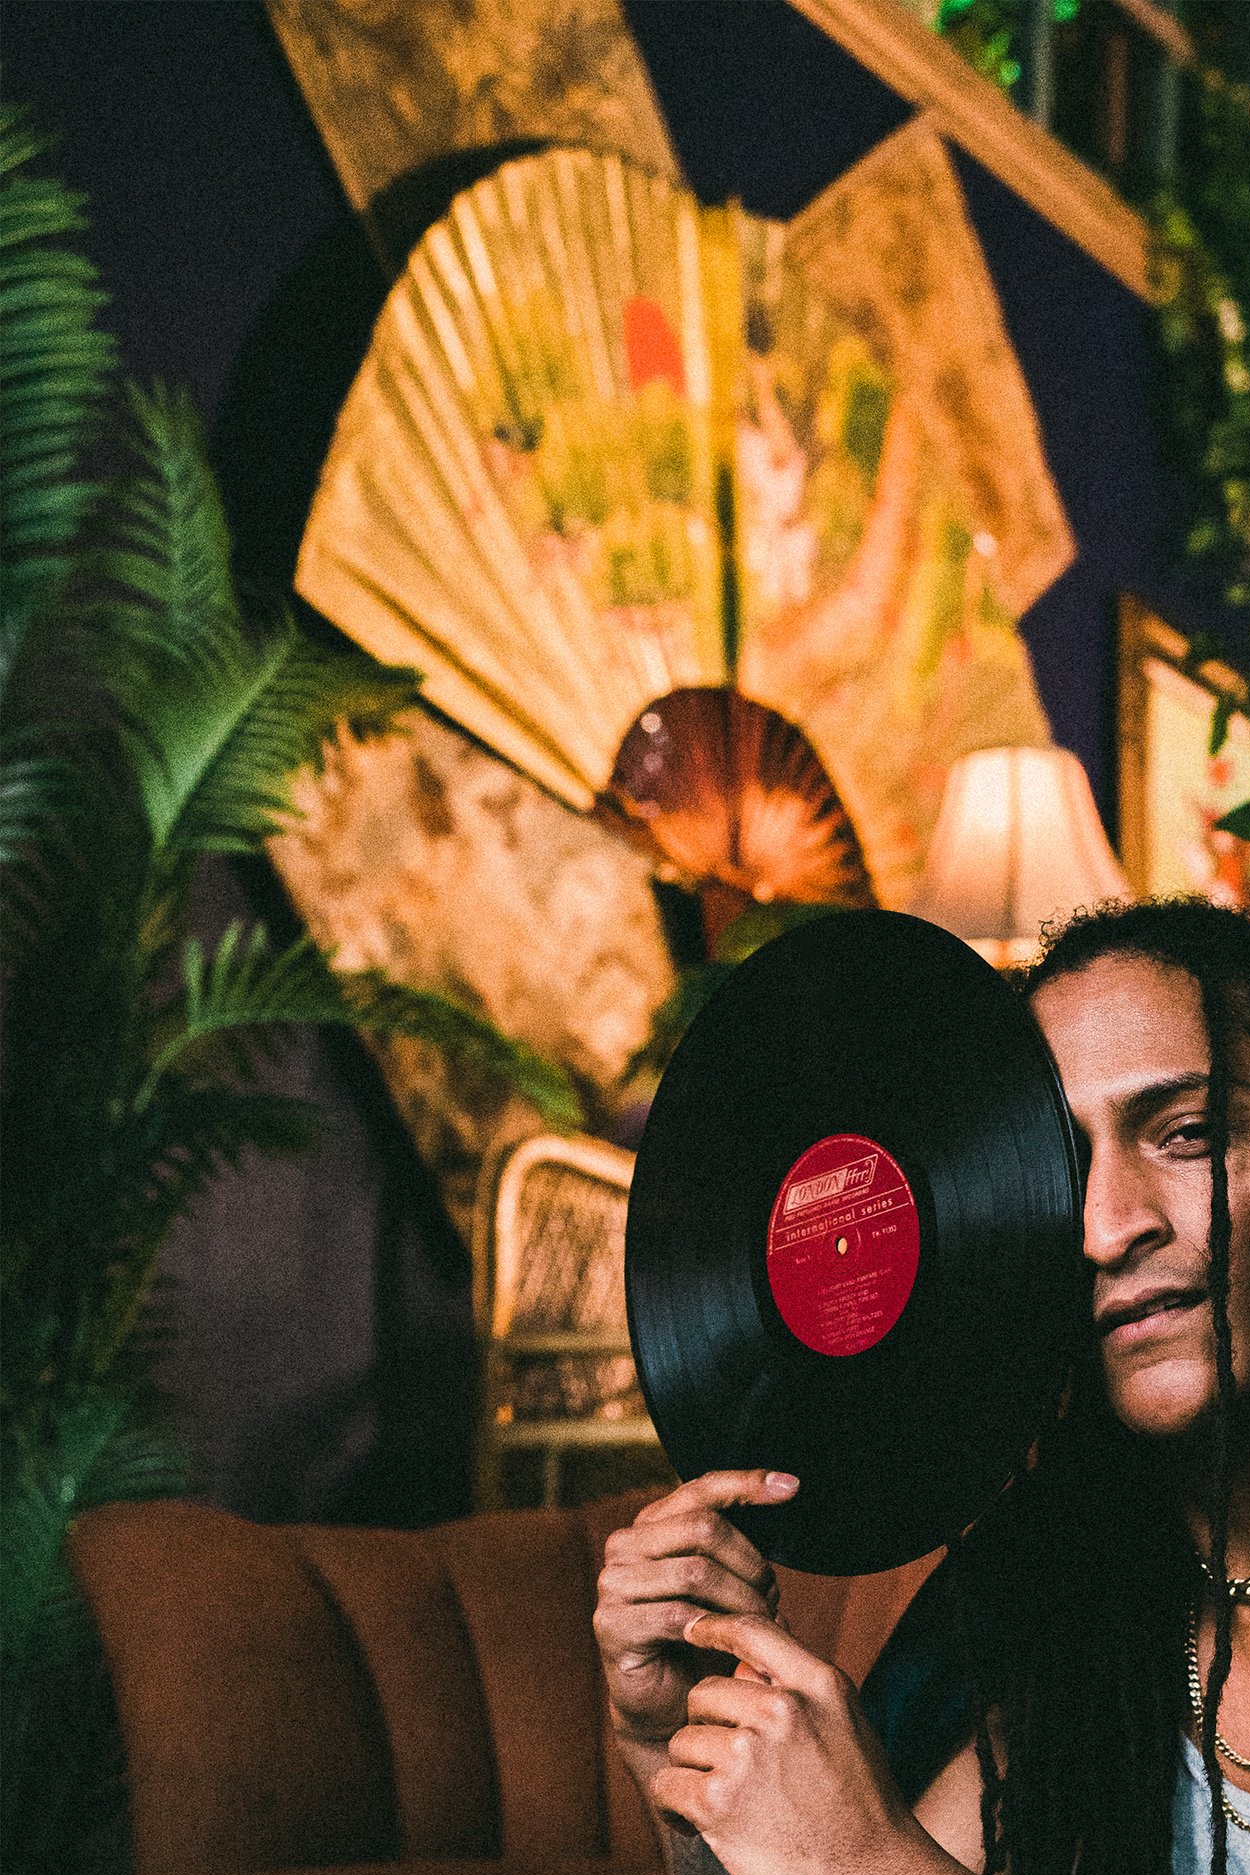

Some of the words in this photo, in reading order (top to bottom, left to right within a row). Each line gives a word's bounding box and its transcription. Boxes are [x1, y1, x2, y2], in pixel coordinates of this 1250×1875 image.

[790, 1174, 841, 1206] LONDON
[786, 1209, 857, 1242] international
[861, 1198, 893, 1216] series
